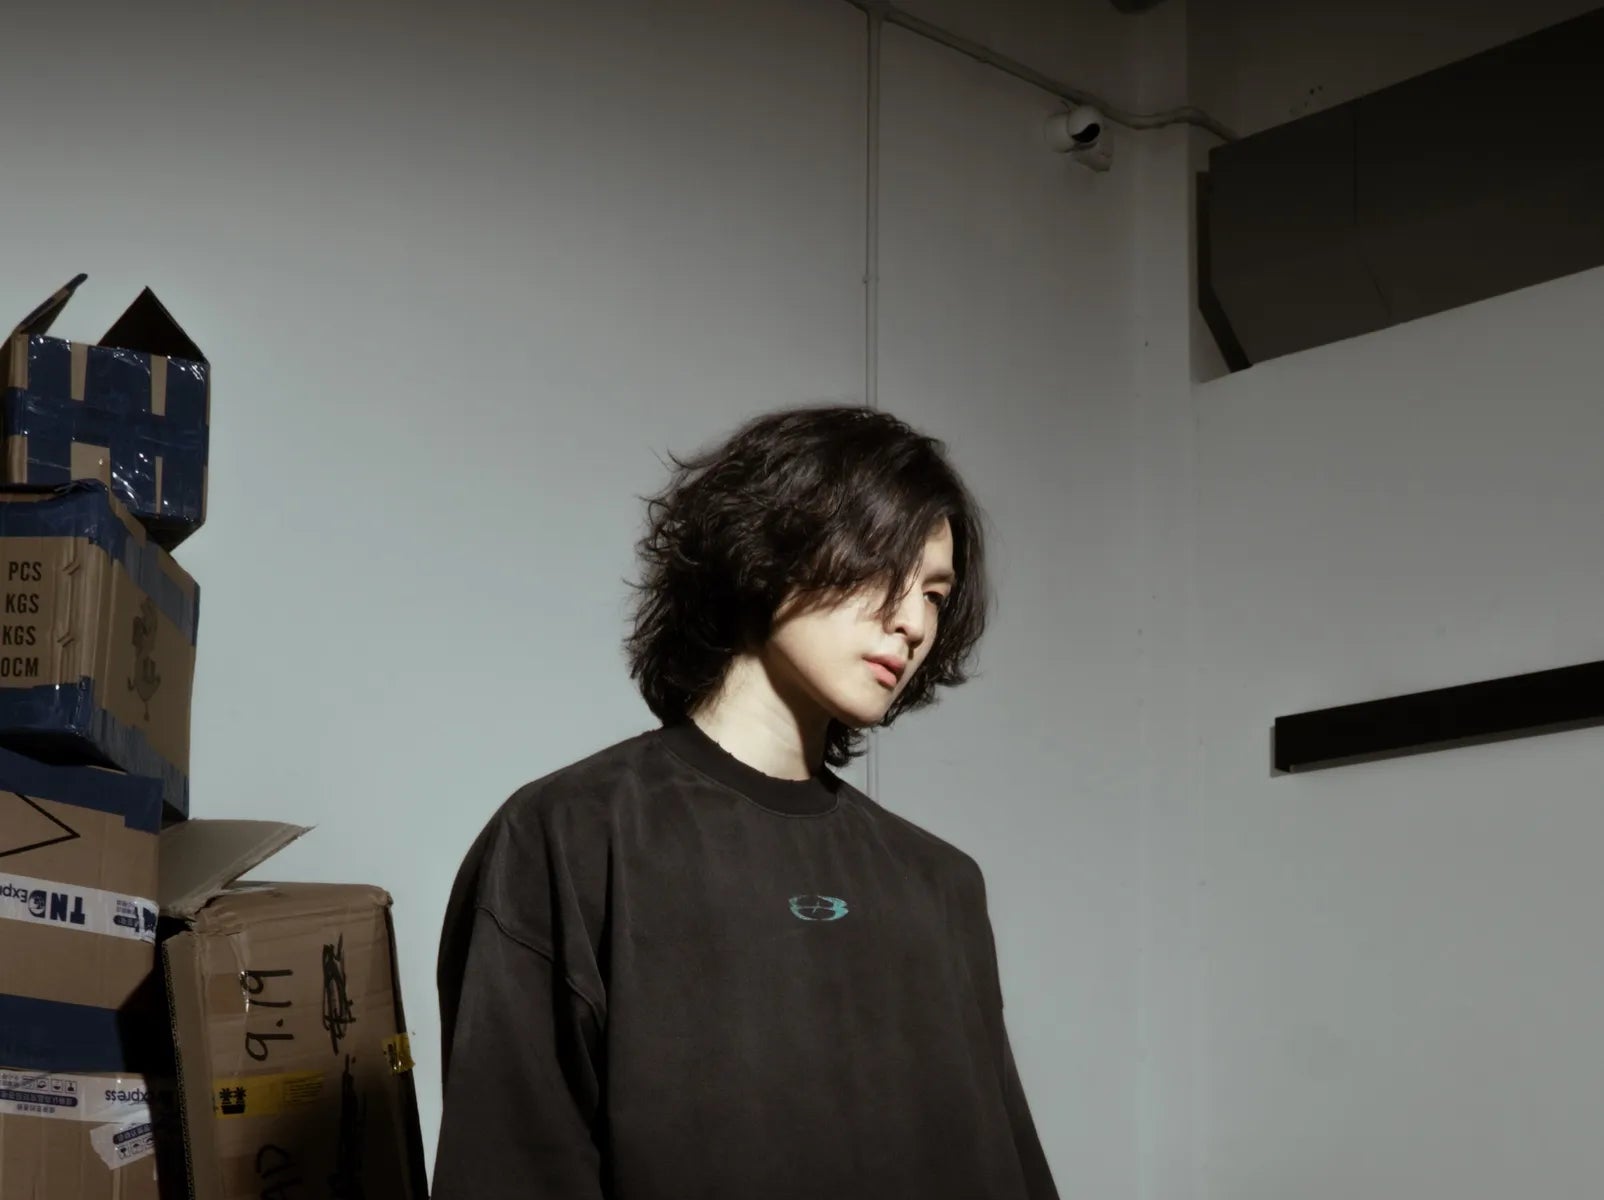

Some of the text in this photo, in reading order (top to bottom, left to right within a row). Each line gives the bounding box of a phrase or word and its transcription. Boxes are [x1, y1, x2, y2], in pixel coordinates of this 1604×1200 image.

[9, 562, 42, 581] PCS
[6, 593, 39, 613] KGS
[2, 625, 36, 645] KGS
[239, 969, 294, 1061] 9.19
